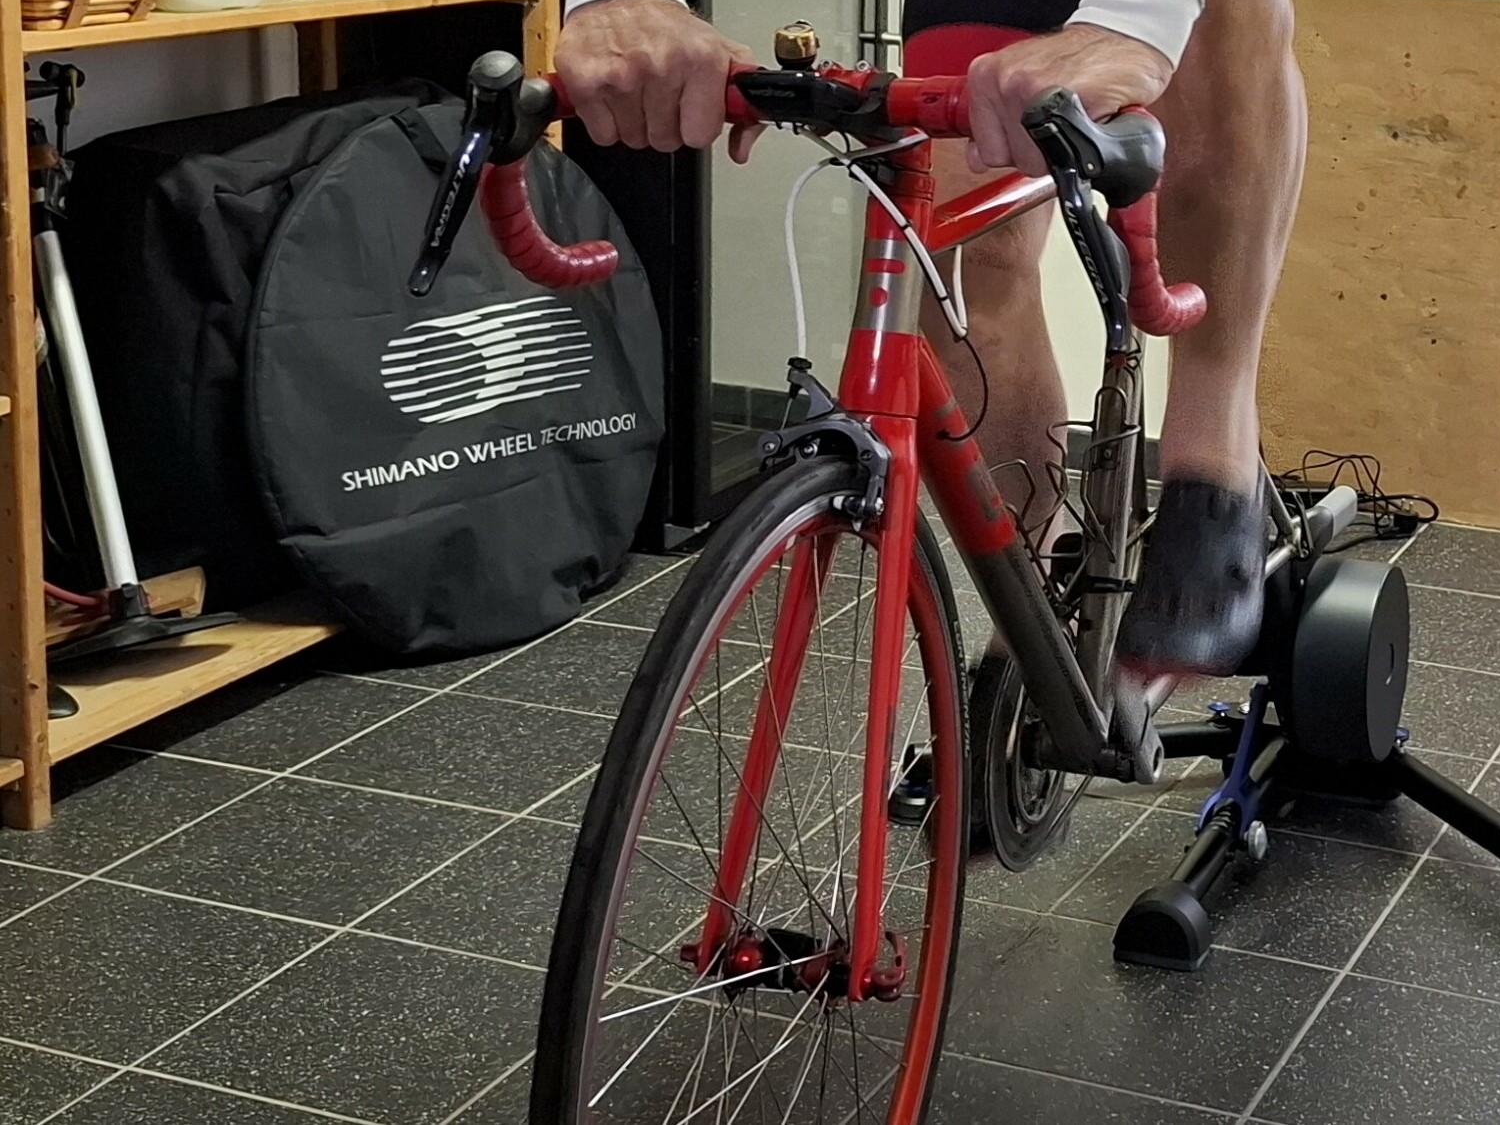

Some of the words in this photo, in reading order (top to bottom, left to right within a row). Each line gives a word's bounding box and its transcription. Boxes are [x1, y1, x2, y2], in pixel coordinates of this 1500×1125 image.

[341, 450, 460, 492] SHIMANO
[463, 433, 538, 464] WHEEL
[540, 412, 637, 446] TECHNOLOGY
